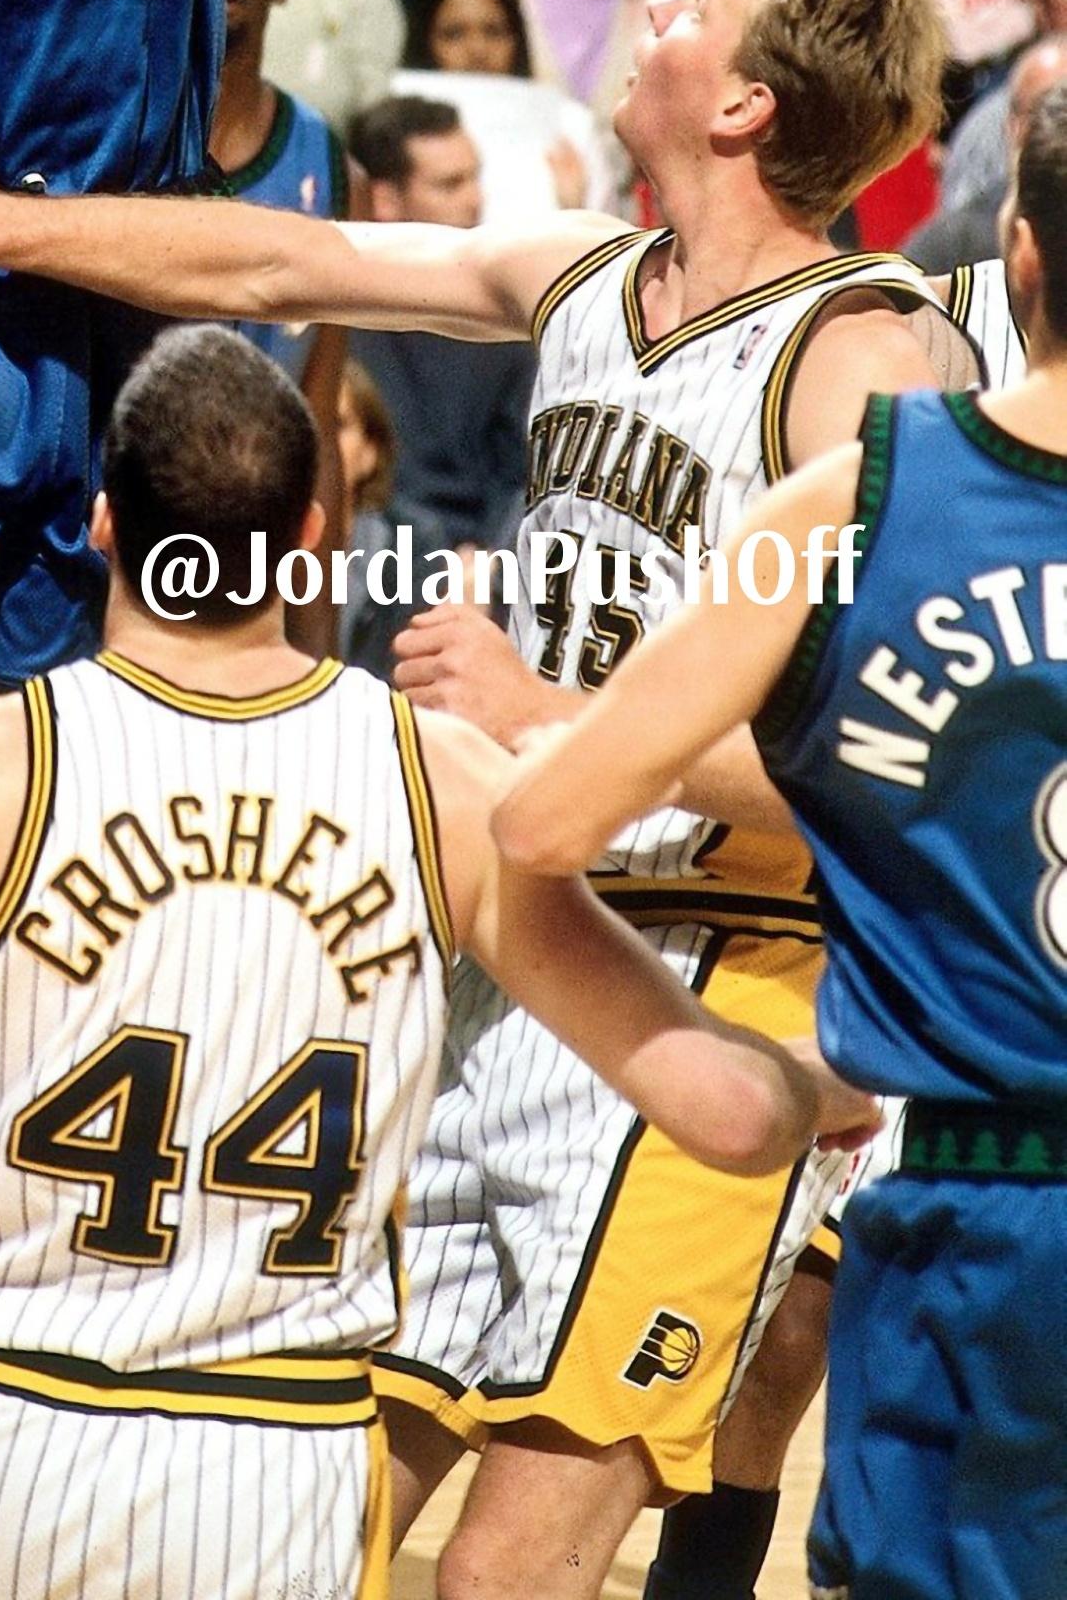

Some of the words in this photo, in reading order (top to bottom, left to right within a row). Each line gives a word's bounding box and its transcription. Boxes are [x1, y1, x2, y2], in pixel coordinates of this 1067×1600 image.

[535, 528, 651, 693] 45
[13, 793, 423, 1006] CROSHERE
[6, 1022, 370, 1277] 44
